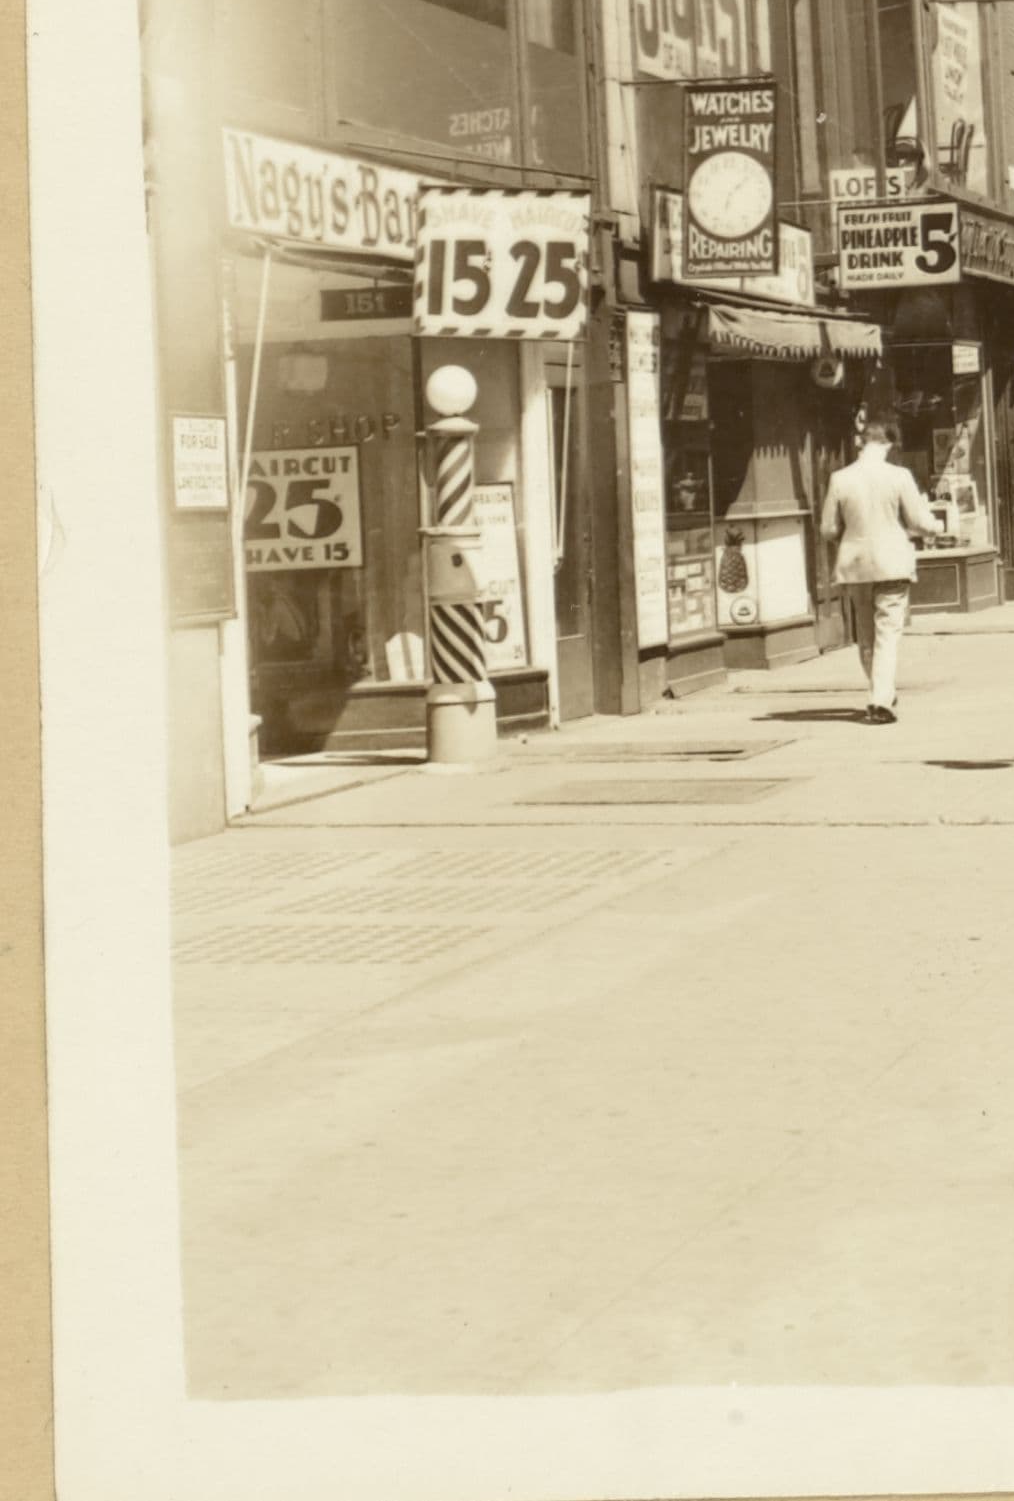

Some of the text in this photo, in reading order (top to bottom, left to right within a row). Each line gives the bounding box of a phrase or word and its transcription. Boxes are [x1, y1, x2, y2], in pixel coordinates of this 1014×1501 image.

[691, 90, 774, 116] WATCHES
[688, 123, 774, 153] JEWELRY
[228, 133, 349, 243] Nagy's
[832, 176, 901, 197] LOFS
[844, 211, 912, 226] FRESH FRUIT
[688, 223, 772, 260] REPAIRING
[841, 226, 918, 250] PINEAPPLE
[847, 251, 904, 270] DRINK
[250, 455, 351, 477] AIRCUT
[246, 546, 314, 565] HAVE
